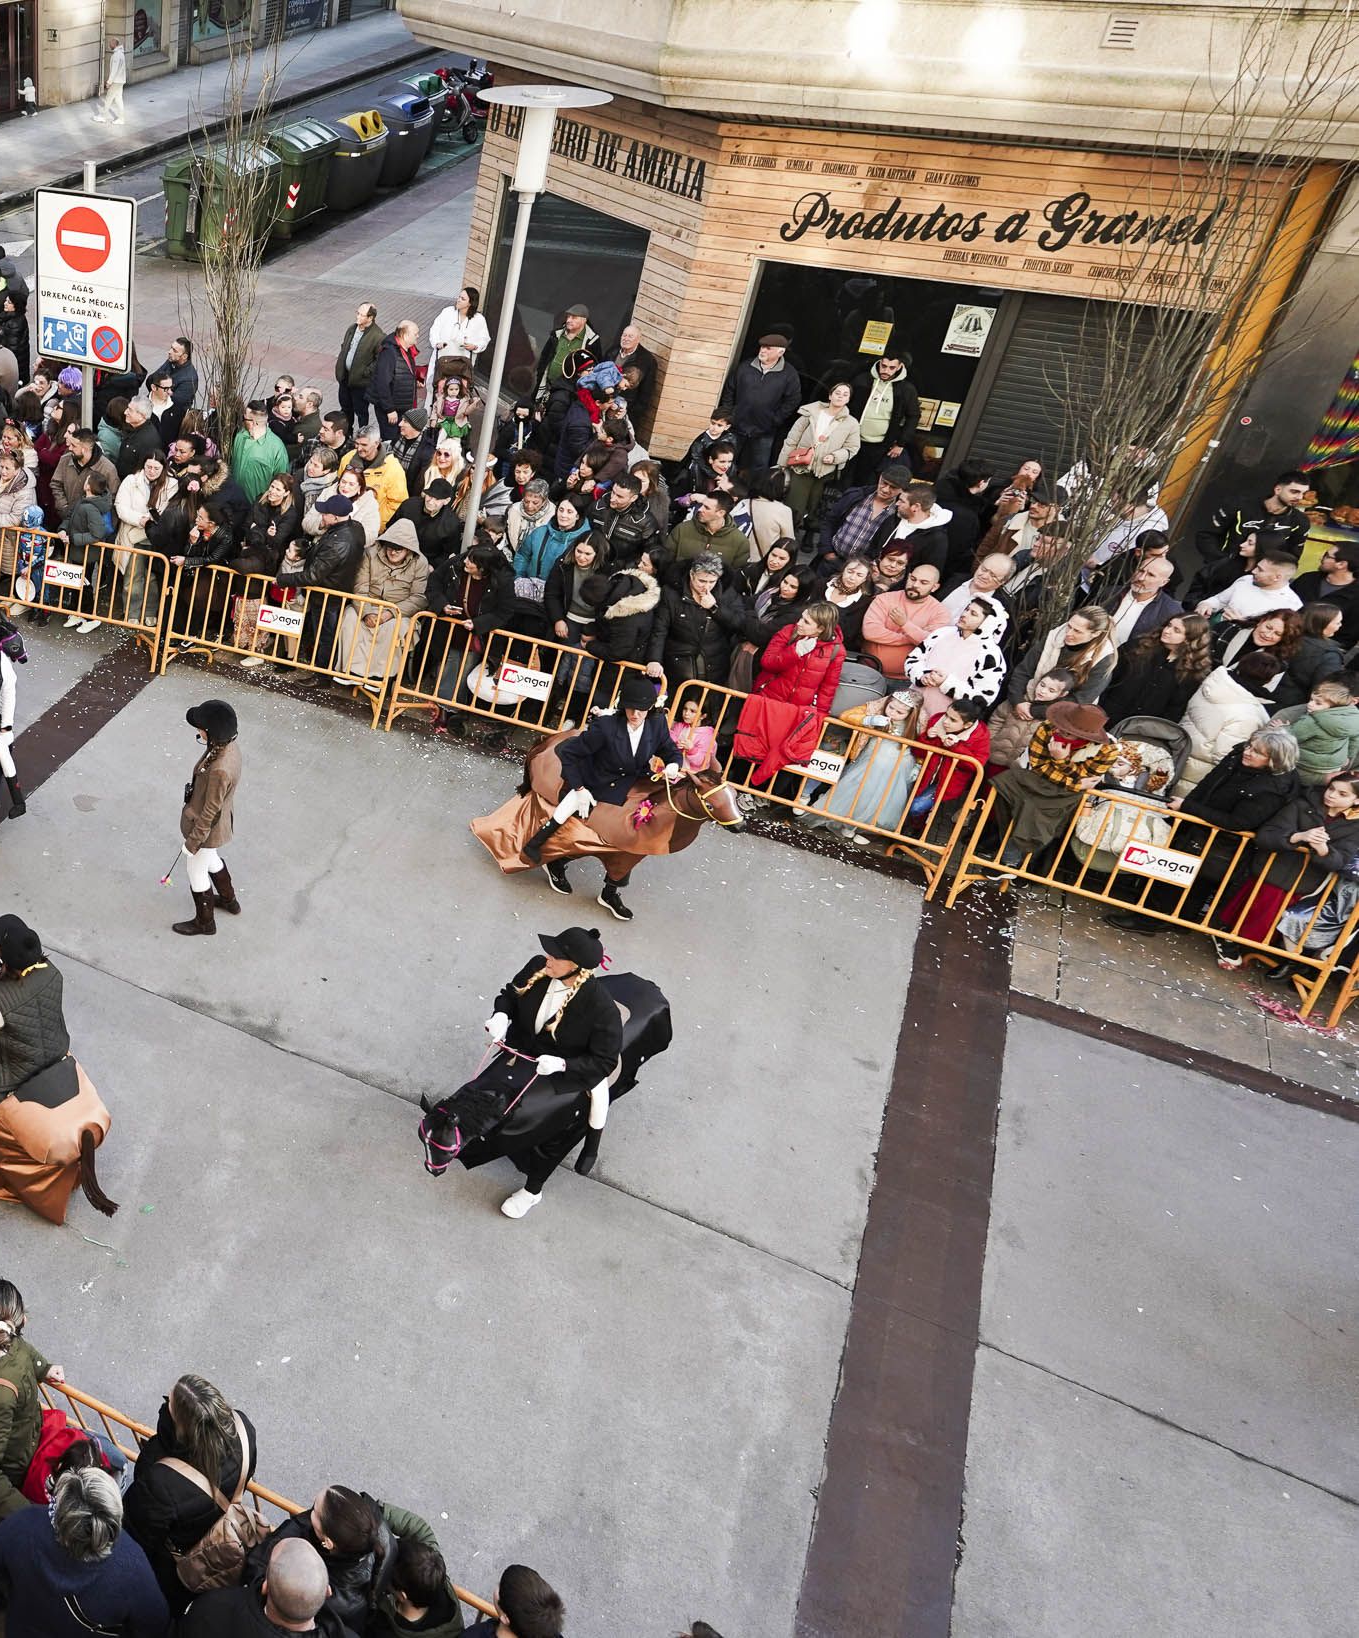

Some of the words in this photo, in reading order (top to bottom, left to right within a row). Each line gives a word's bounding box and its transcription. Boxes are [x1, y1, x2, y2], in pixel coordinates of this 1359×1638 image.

[593, 129, 623, 173] DE
[622, 139, 706, 202] AMELIA
[753, 156, 778, 168] LICORES
[866, 166, 886, 178] PASTA
[924, 171, 942, 183] GRAN
[943, 173, 948, 184] E
[949, 174, 981, 187] LEGUMES
[780, 191, 988, 242] Produtos
[994, 209, 1031, 243] a
[1038, 191, 1229, 252] Granel
[943, 249, 970, 262] HERBAS
[970, 252, 1009, 267] MEDICINAIS
[1051, 262, 1074, 274] SECOS
[71, 284, 94, 294] AGAS
[41, 290, 86, 304] URXENCIAS
[70, 307, 102, 319] GARAXE
